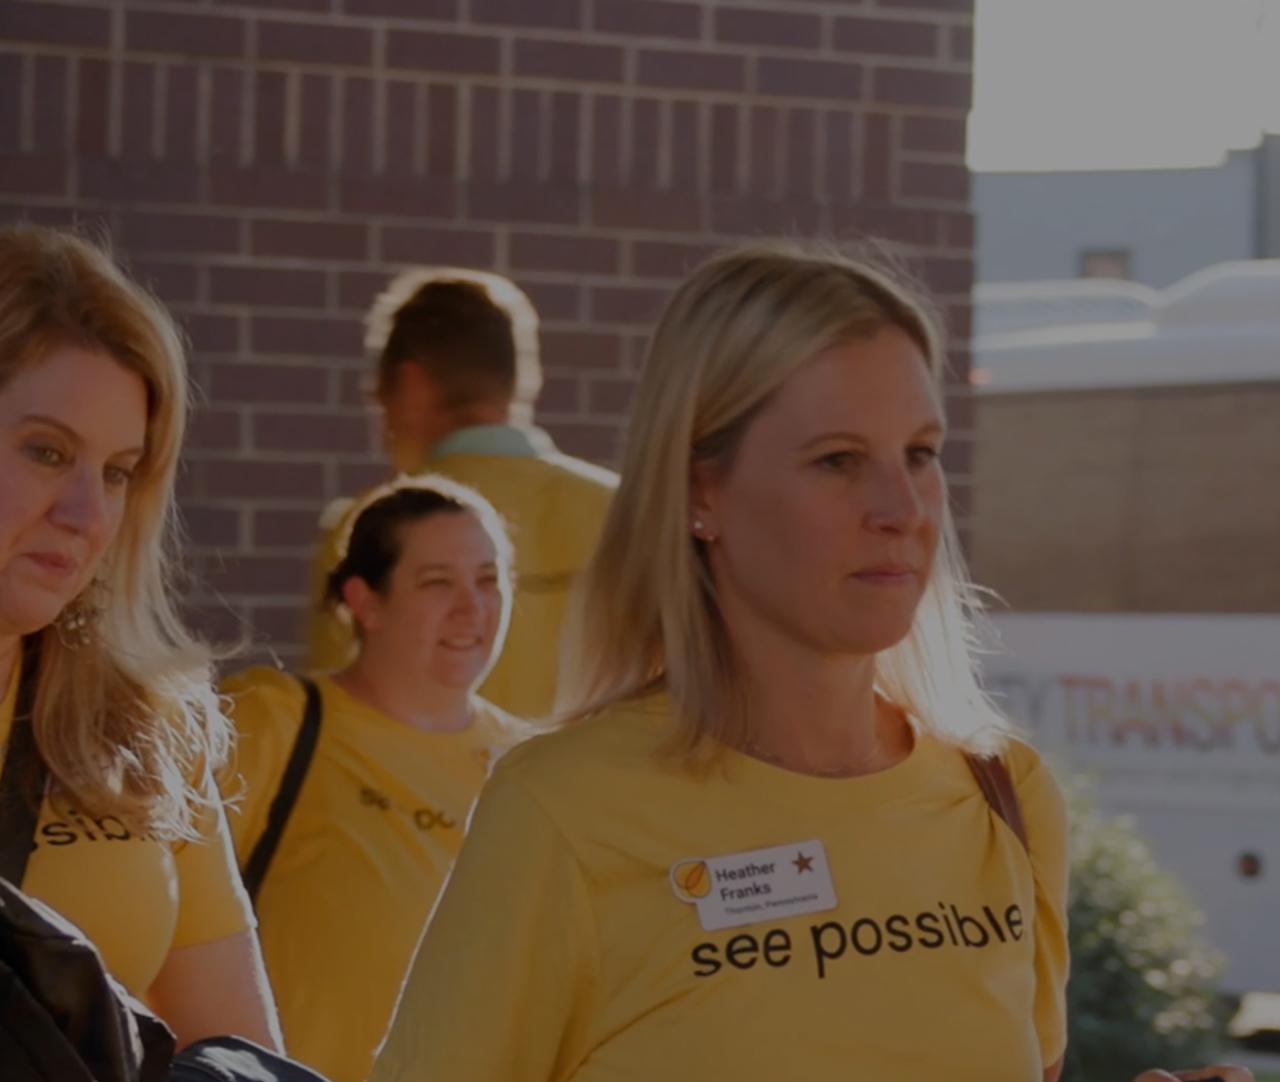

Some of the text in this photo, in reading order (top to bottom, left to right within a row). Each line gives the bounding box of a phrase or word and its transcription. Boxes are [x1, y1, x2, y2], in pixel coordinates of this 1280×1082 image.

[715, 862, 776, 883] Heather
[720, 881, 772, 902] Franks
[691, 901, 1023, 979] see possible
